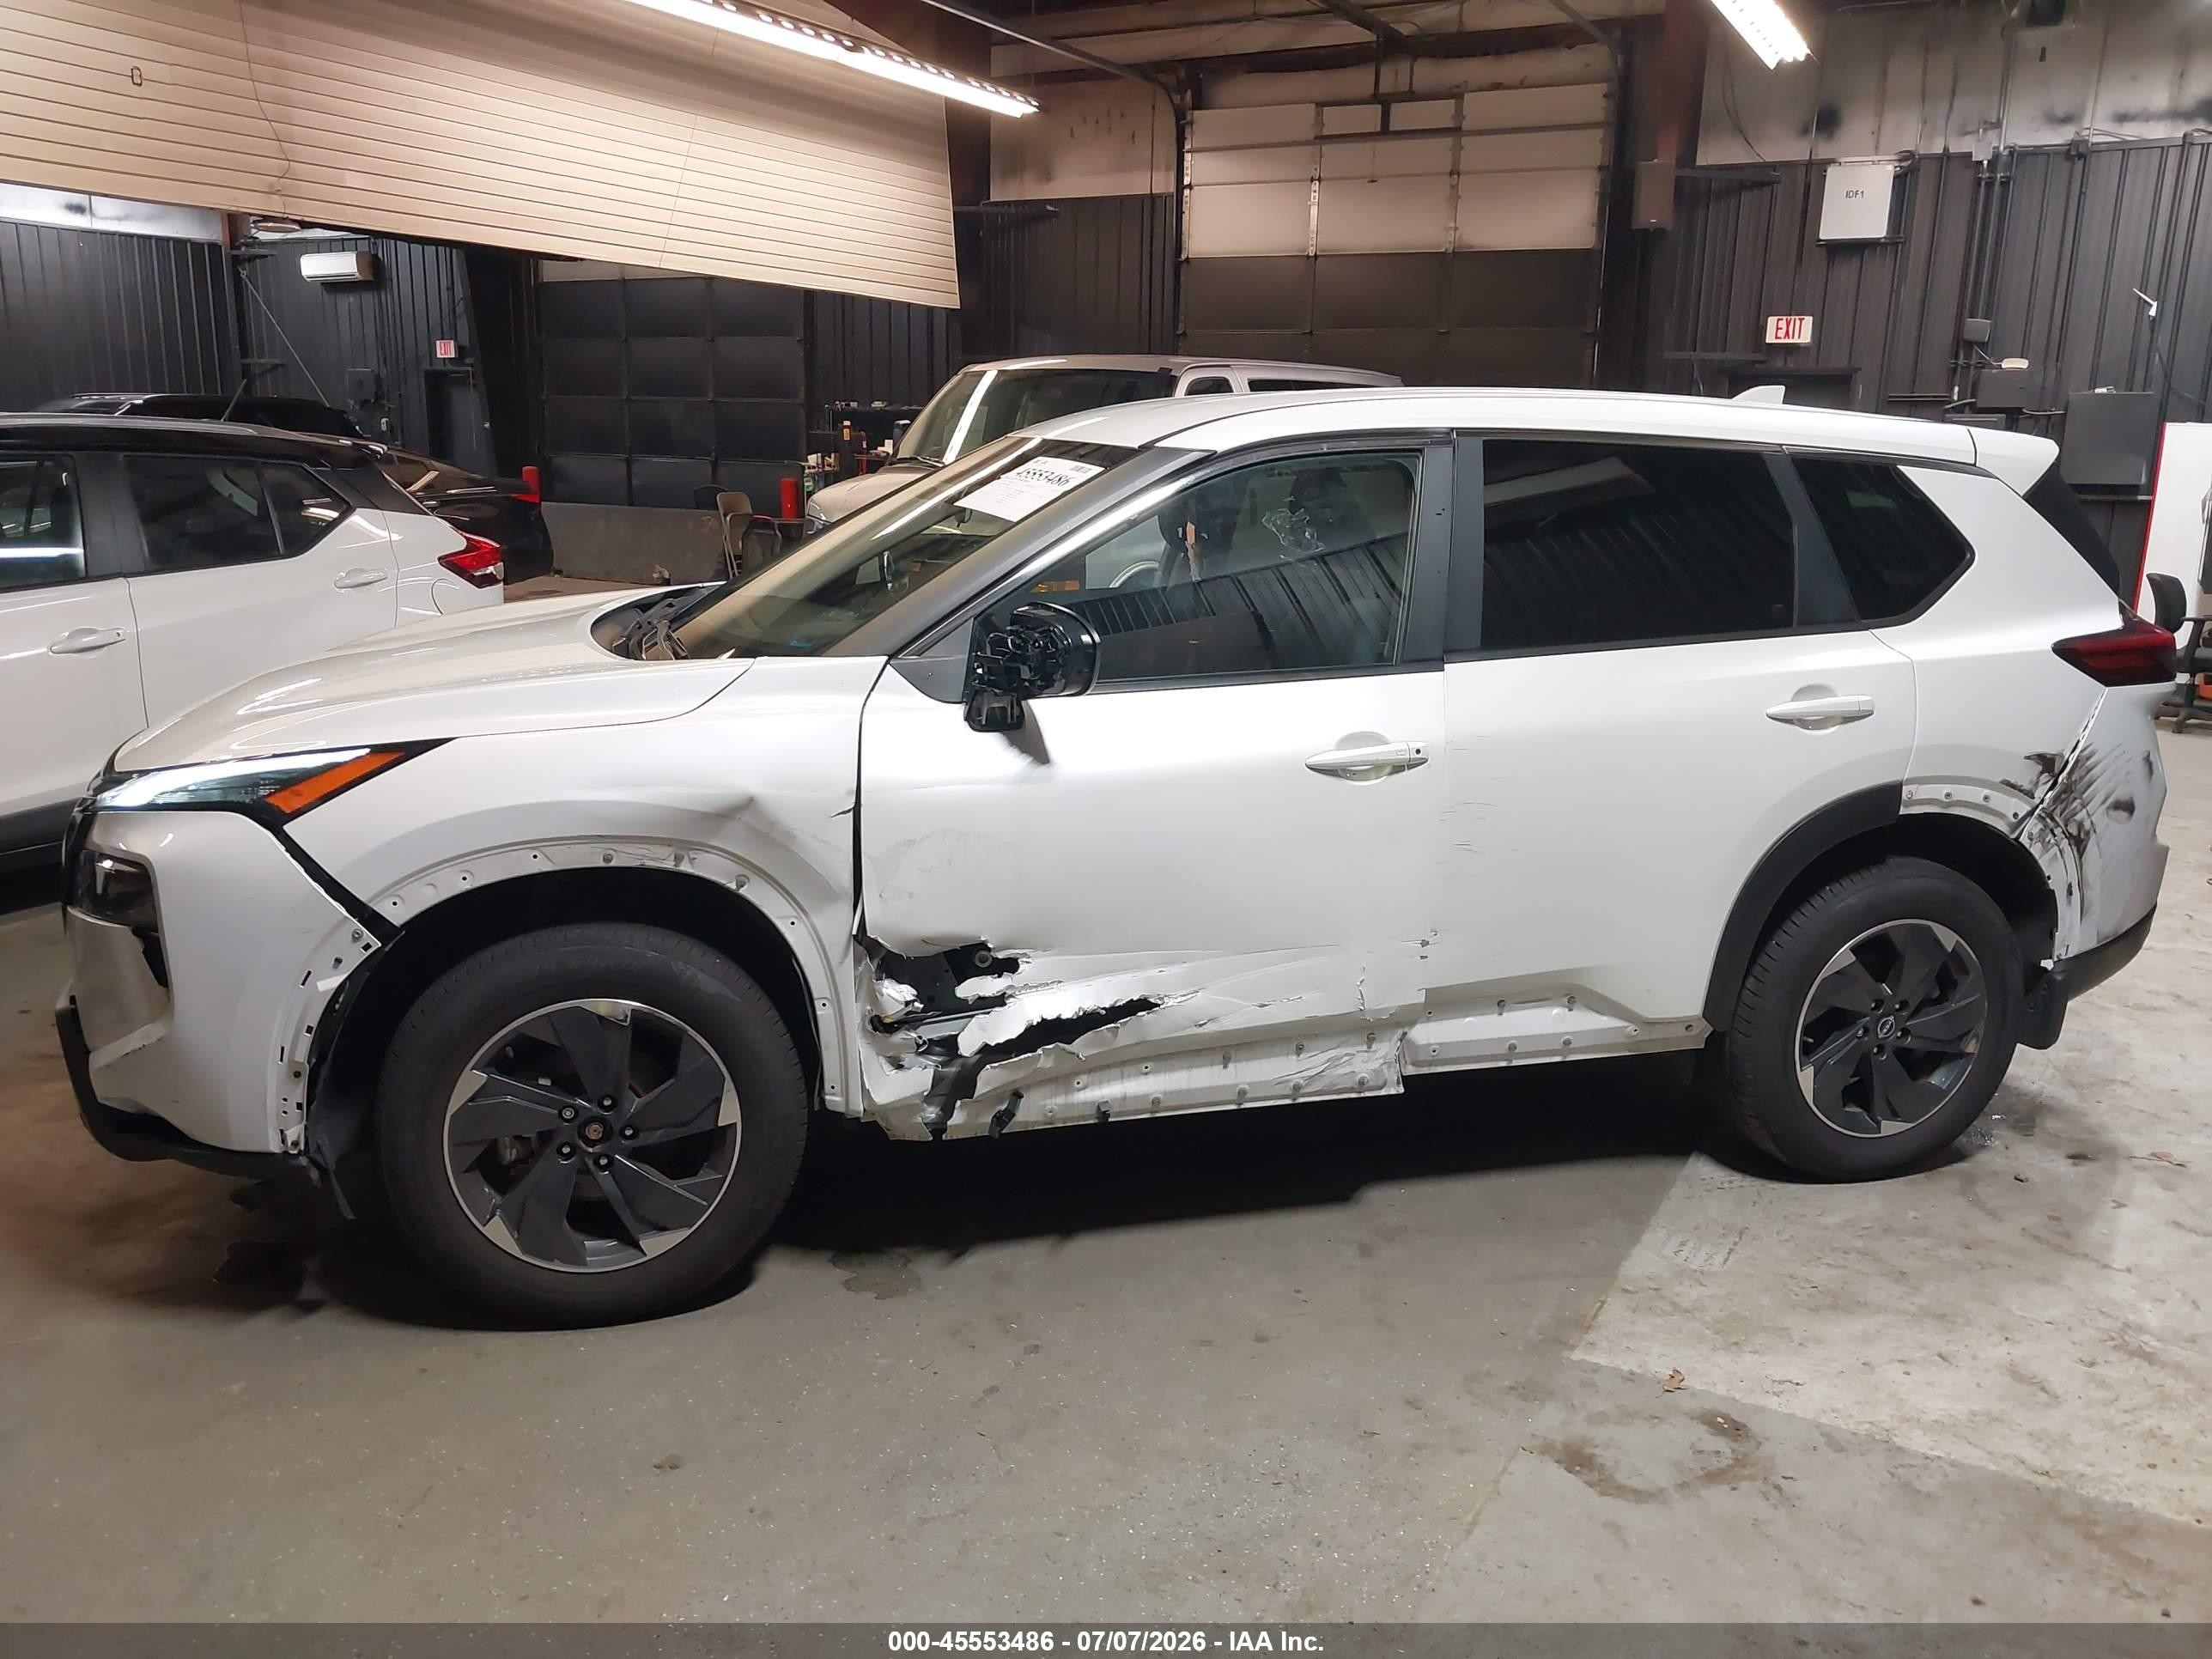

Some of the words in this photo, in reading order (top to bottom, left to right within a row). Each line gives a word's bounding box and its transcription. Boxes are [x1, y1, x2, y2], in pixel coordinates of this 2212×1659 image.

[1845, 190, 1864, 199] IDF1
[1775, 317, 1805, 340] EXIT
[440, 342, 451, 356] EXIT
